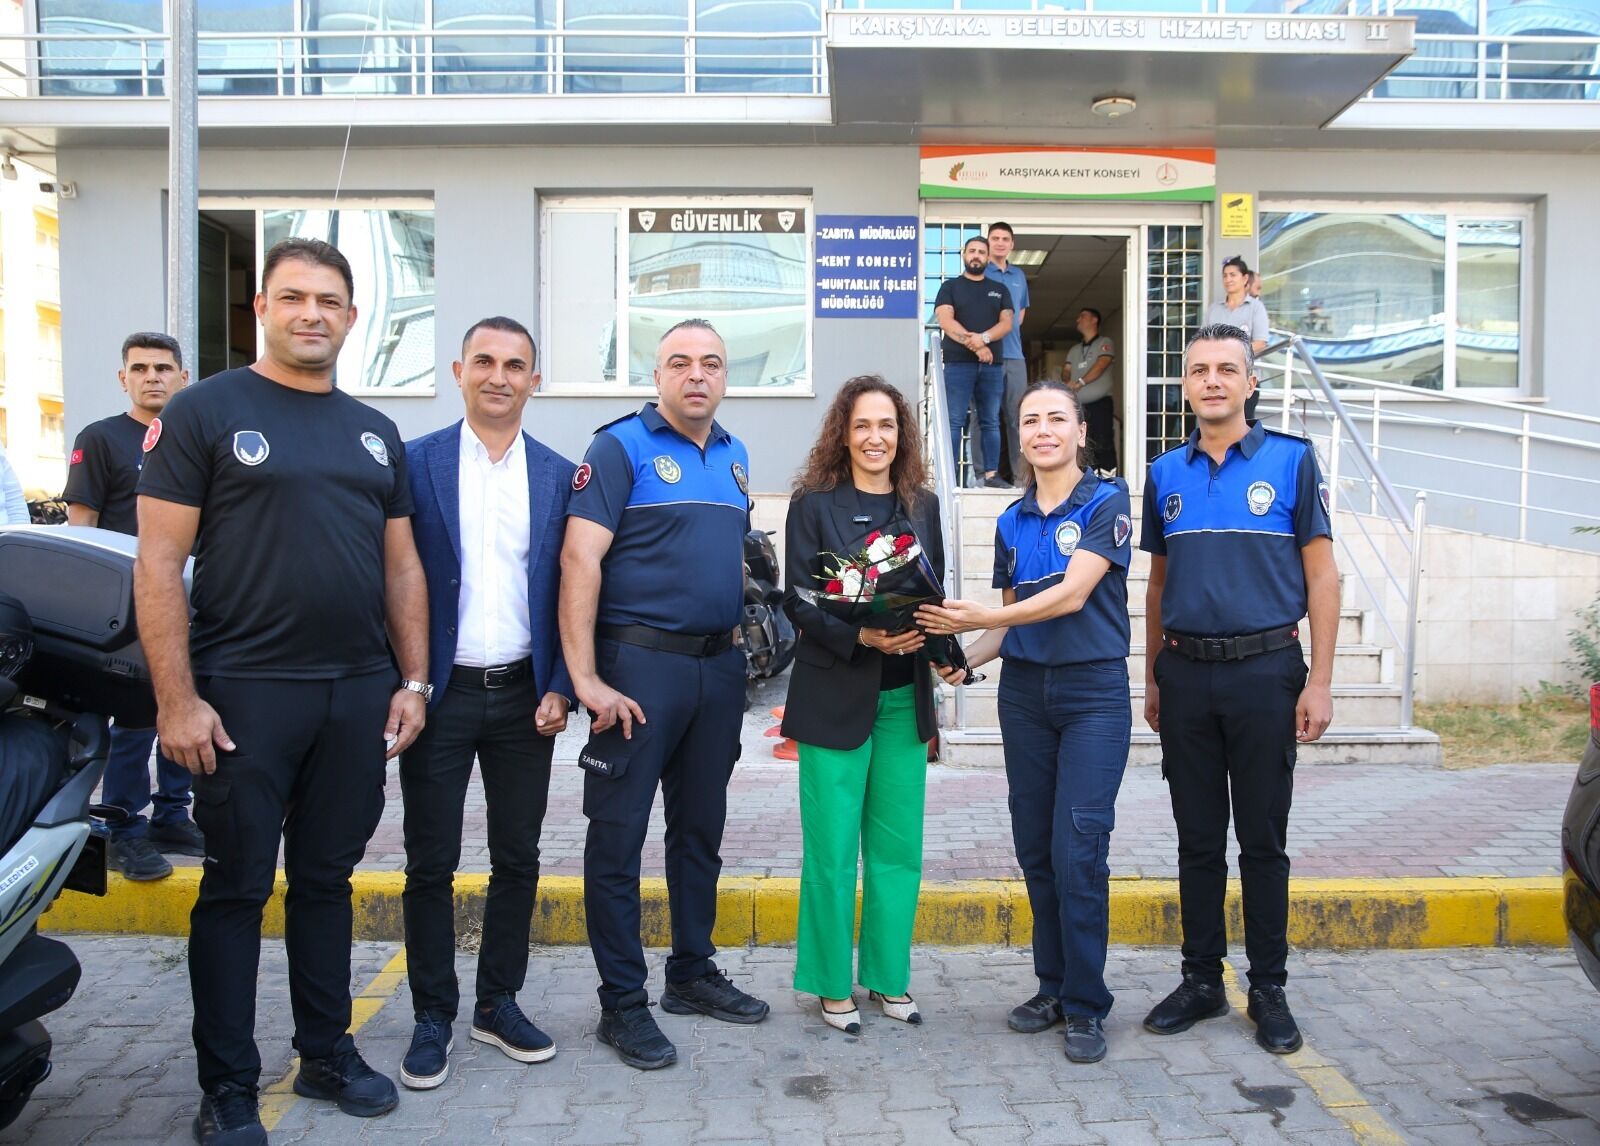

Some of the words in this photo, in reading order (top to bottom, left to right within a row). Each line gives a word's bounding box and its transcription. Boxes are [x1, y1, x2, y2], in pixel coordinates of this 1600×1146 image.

[850, 16, 991, 40] KARŞIYAKA
[1366, 21, 1390, 41] II
[999, 168, 1060, 178] KARŞIYAKA
[1063, 168, 1091, 178] KENT
[1094, 168, 1140, 179] KONSEYİ
[670, 209, 763, 232] GÜVENLİK
[859, 225, 916, 241] MÜDÜRLÜĞÜ
[856, 251, 912, 269] KONSEYİ
[883, 275, 917, 293] İŞLERİ
[821, 294, 885, 310] MÜDÜRLÜĞÜ
[582, 755, 608, 770] ZABITA
[0, 857, 37, 892] ELEDİYESİ
